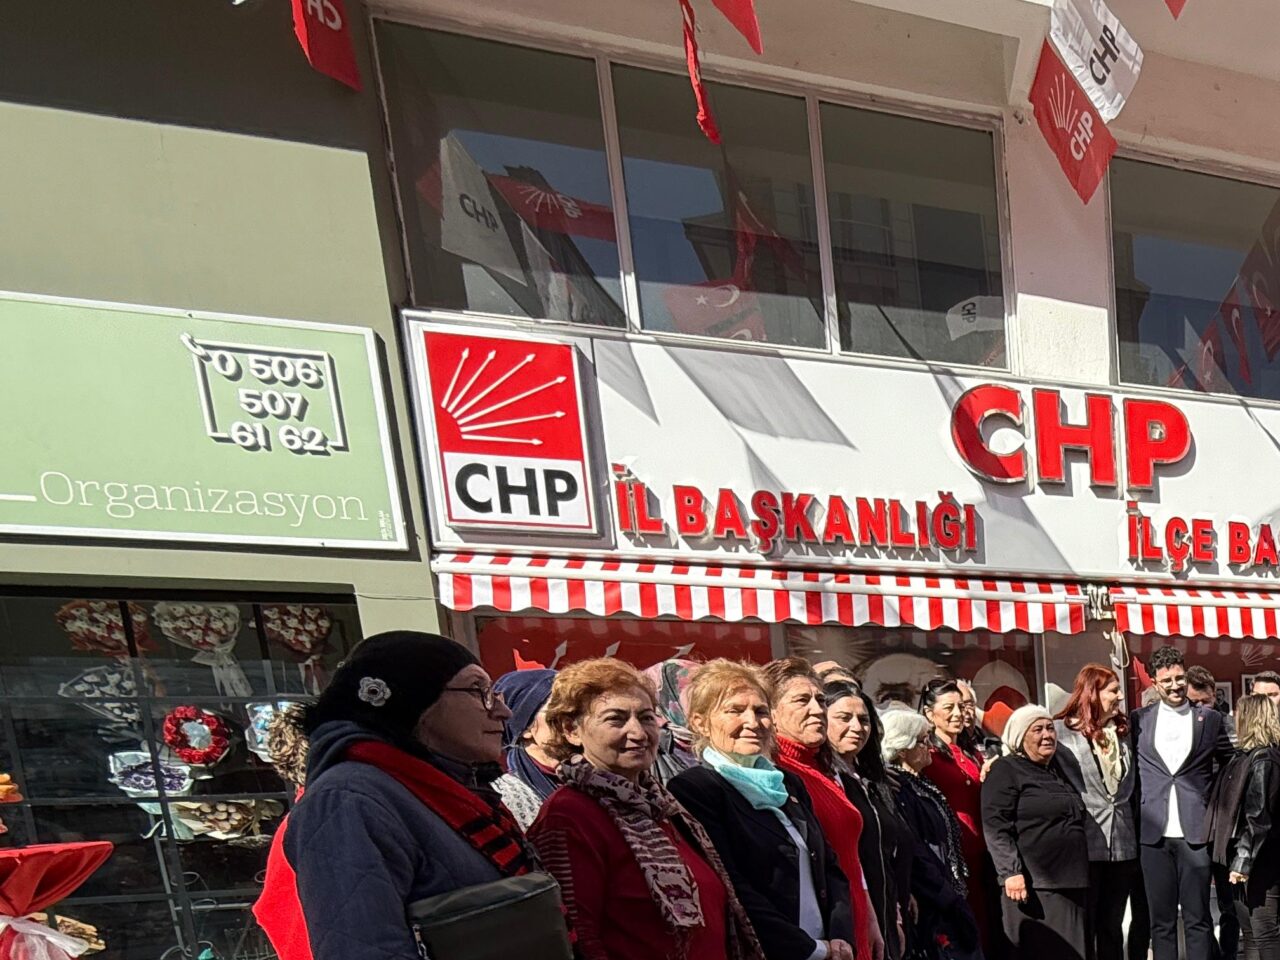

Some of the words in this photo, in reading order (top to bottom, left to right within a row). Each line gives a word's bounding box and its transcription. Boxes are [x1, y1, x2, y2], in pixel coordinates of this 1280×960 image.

[1090, 24, 1121, 86] CHP
[1070, 111, 1095, 161] CHP
[213, 351, 237, 376] 0
[249, 353, 324, 384] 506
[238, 387, 302, 417] 507
[231, 421, 267, 447] 61
[279, 424, 326, 451] 62
[950, 383, 1192, 491] CHP
[40, 471, 369, 527] Organizasyon
[454, 462, 579, 517] CHP
[611, 462, 667, 535] İL
[672, 484, 978, 552] BAŞKANLIĞI
[1126, 500, 1215, 573] İLÇE
